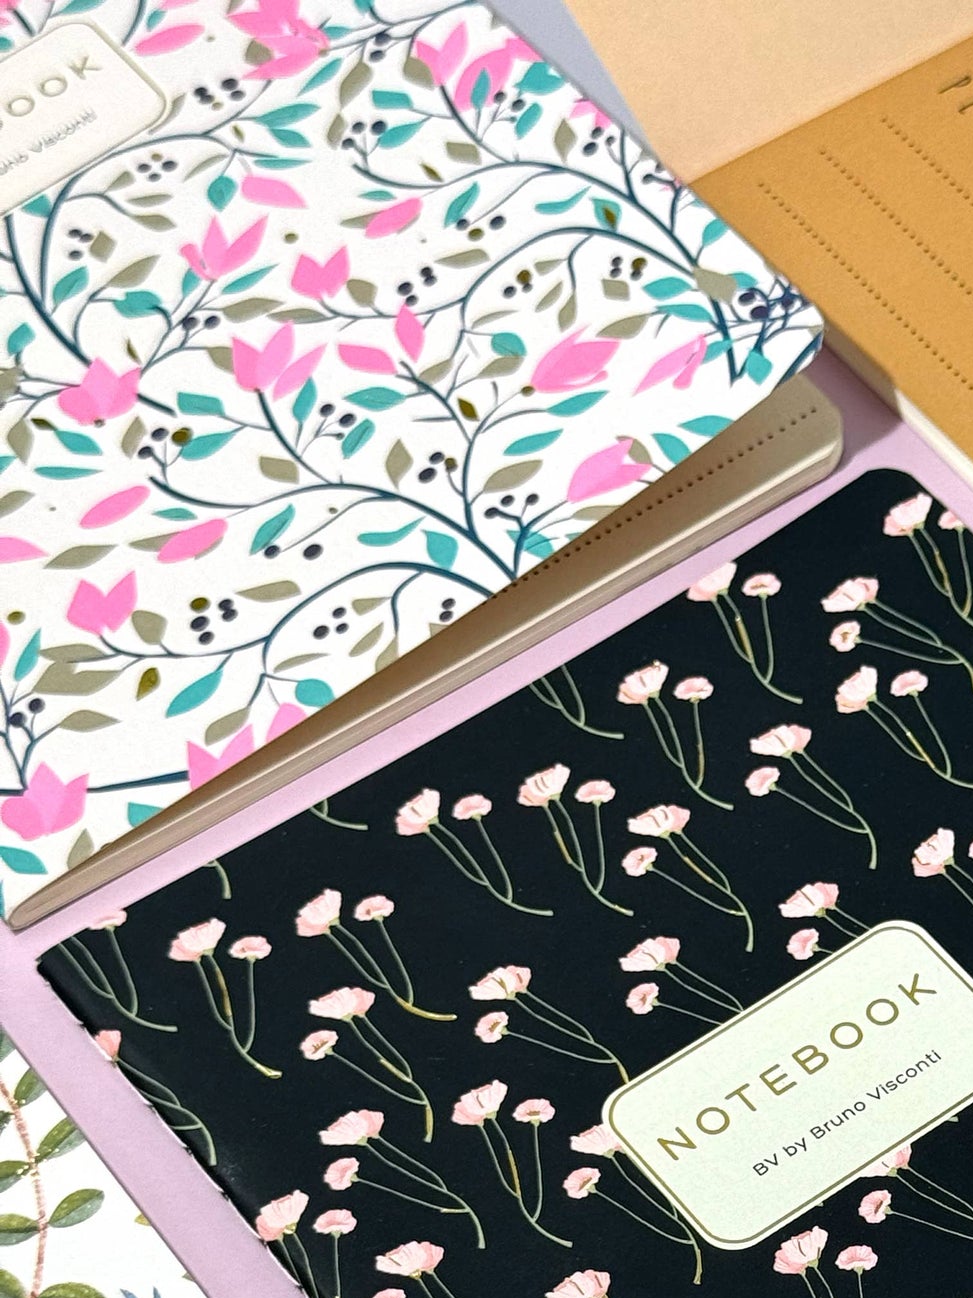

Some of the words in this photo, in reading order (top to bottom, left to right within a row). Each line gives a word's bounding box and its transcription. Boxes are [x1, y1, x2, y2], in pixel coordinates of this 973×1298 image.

[0, 56, 102, 131] OOK
[657, 973, 938, 1161] NOTEBOOK
[752, 1153, 781, 1177] BV
[782, 1134, 809, 1157] by
[809, 1099, 867, 1142] Bruno
[866, 1049, 942, 1101] Visconti
